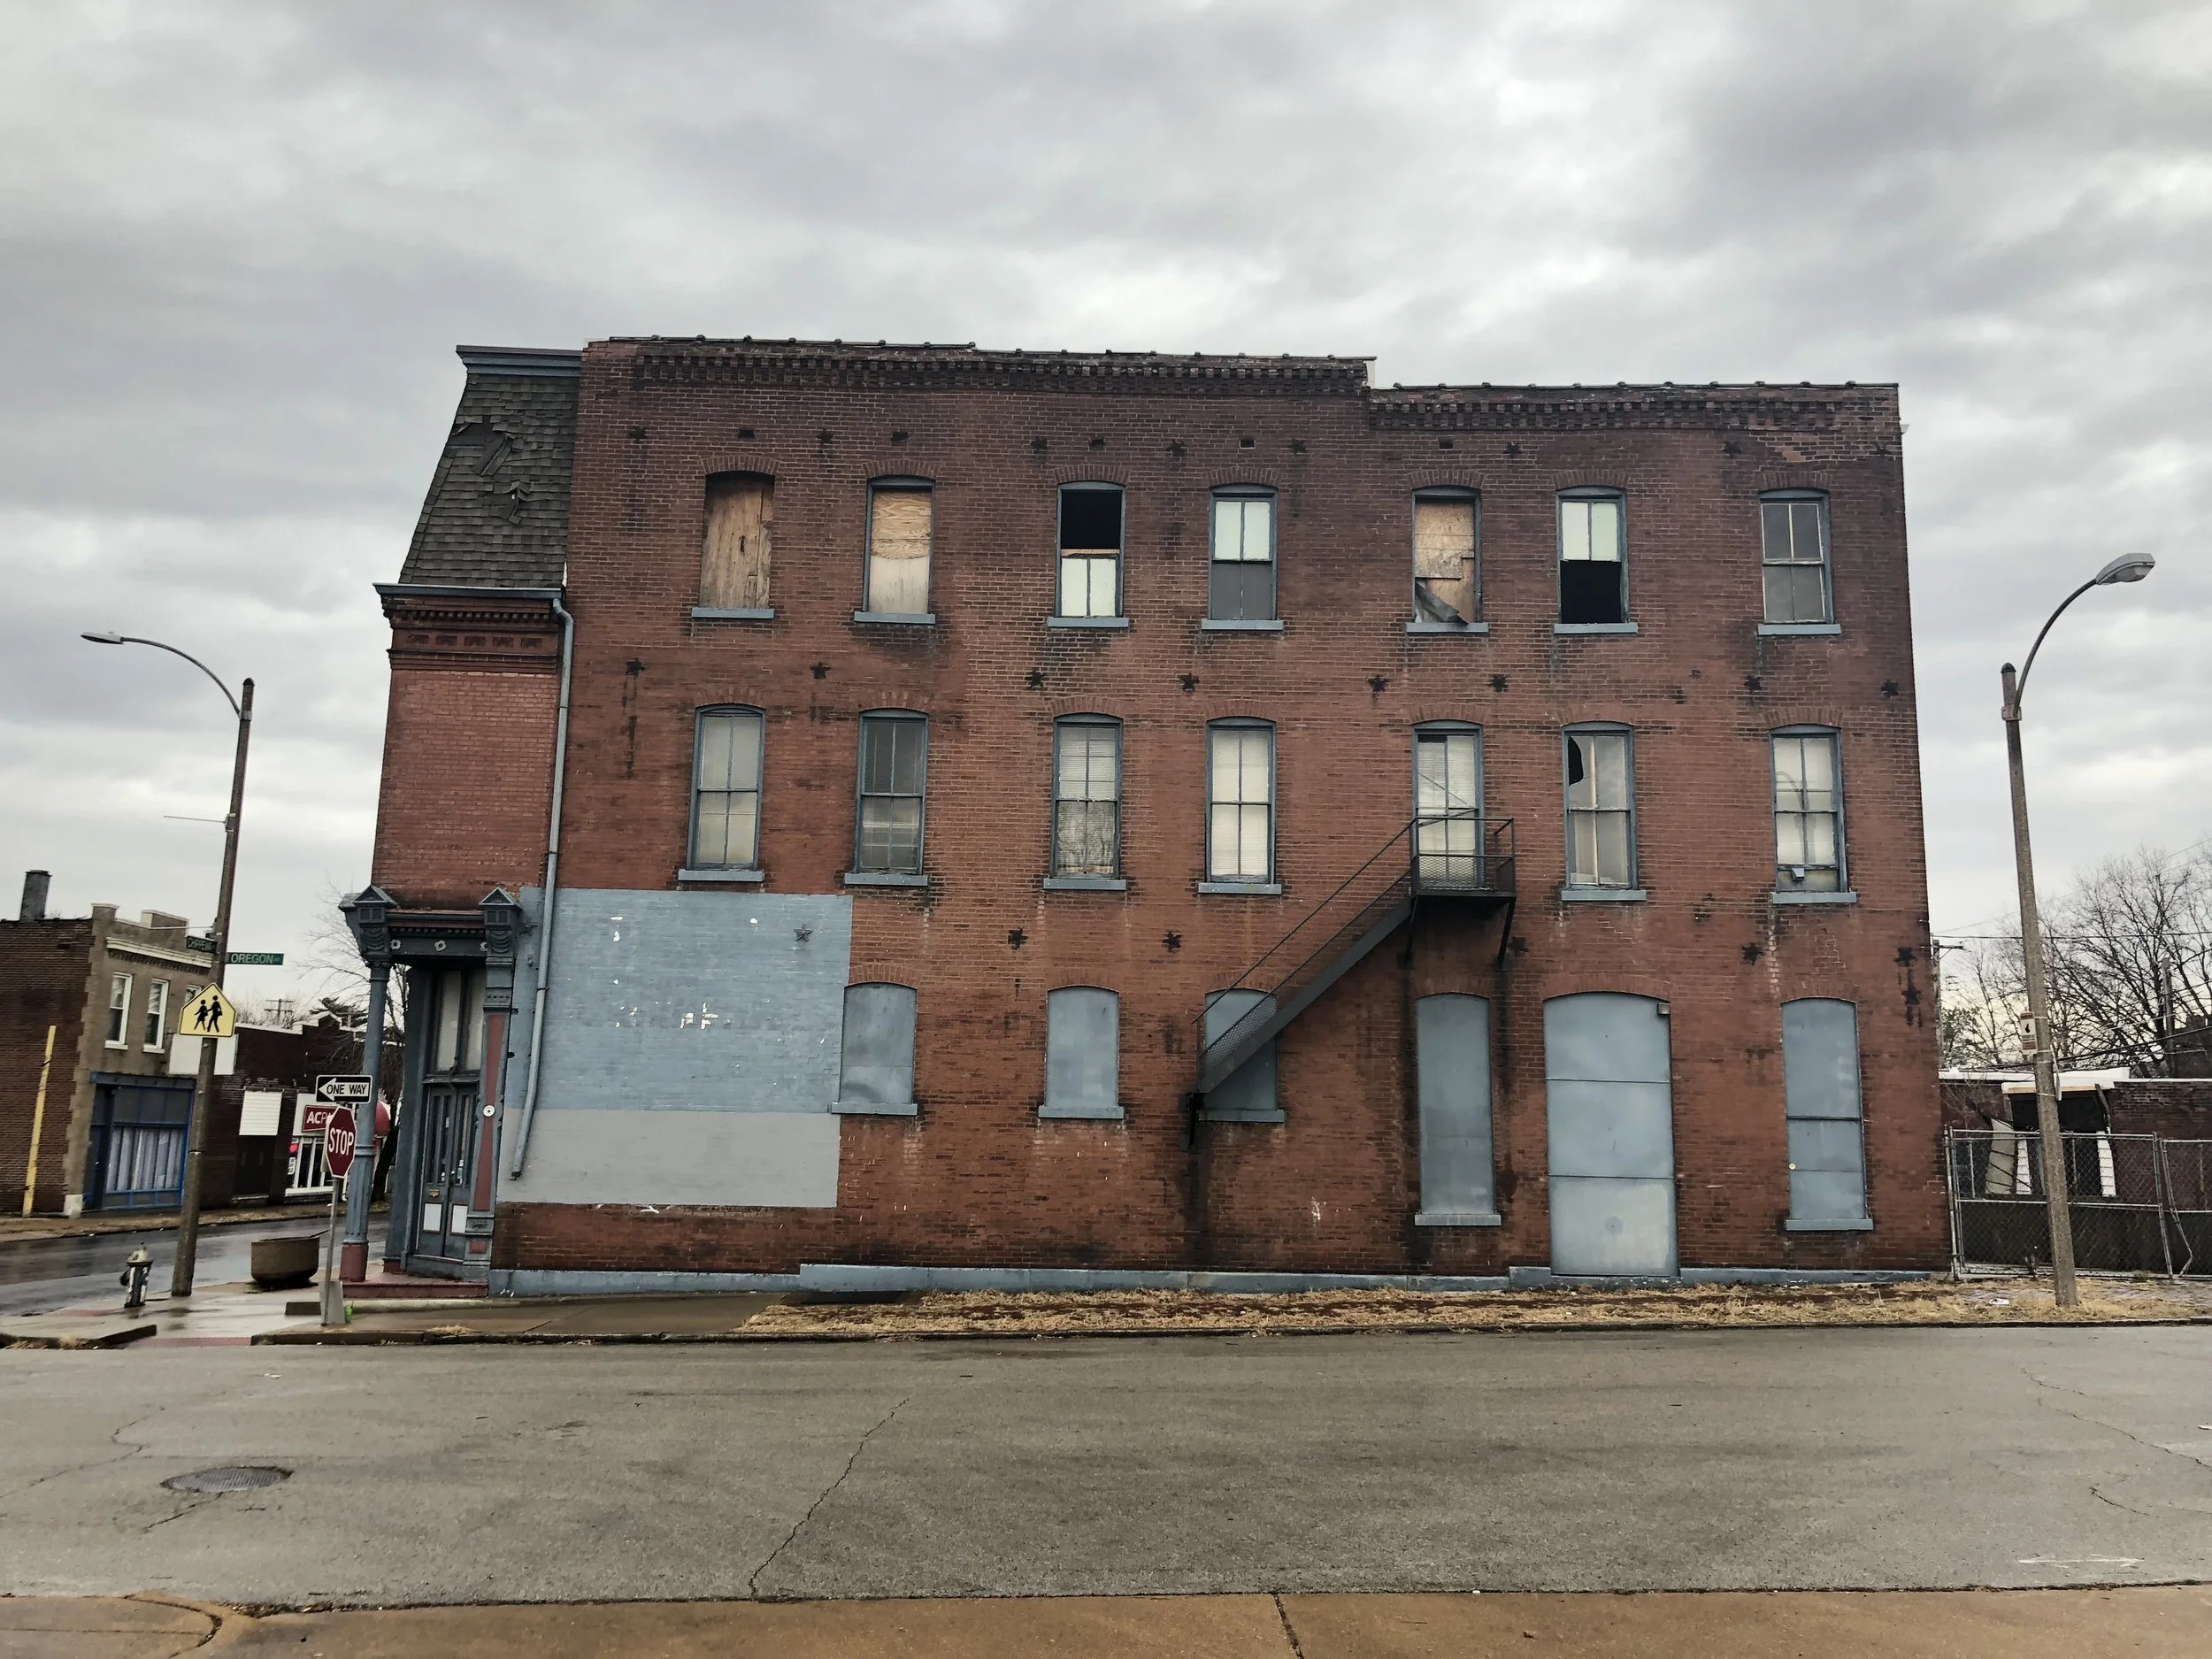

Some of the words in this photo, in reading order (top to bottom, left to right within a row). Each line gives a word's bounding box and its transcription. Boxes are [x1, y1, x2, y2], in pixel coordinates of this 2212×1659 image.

[231, 953, 273, 964] OREGON
[326, 1084, 345, 1094] ONE
[349, 1084, 367, 1094] WAY
[306, 1110, 331, 1124] ACP
[328, 1127, 355, 1156] STOP
